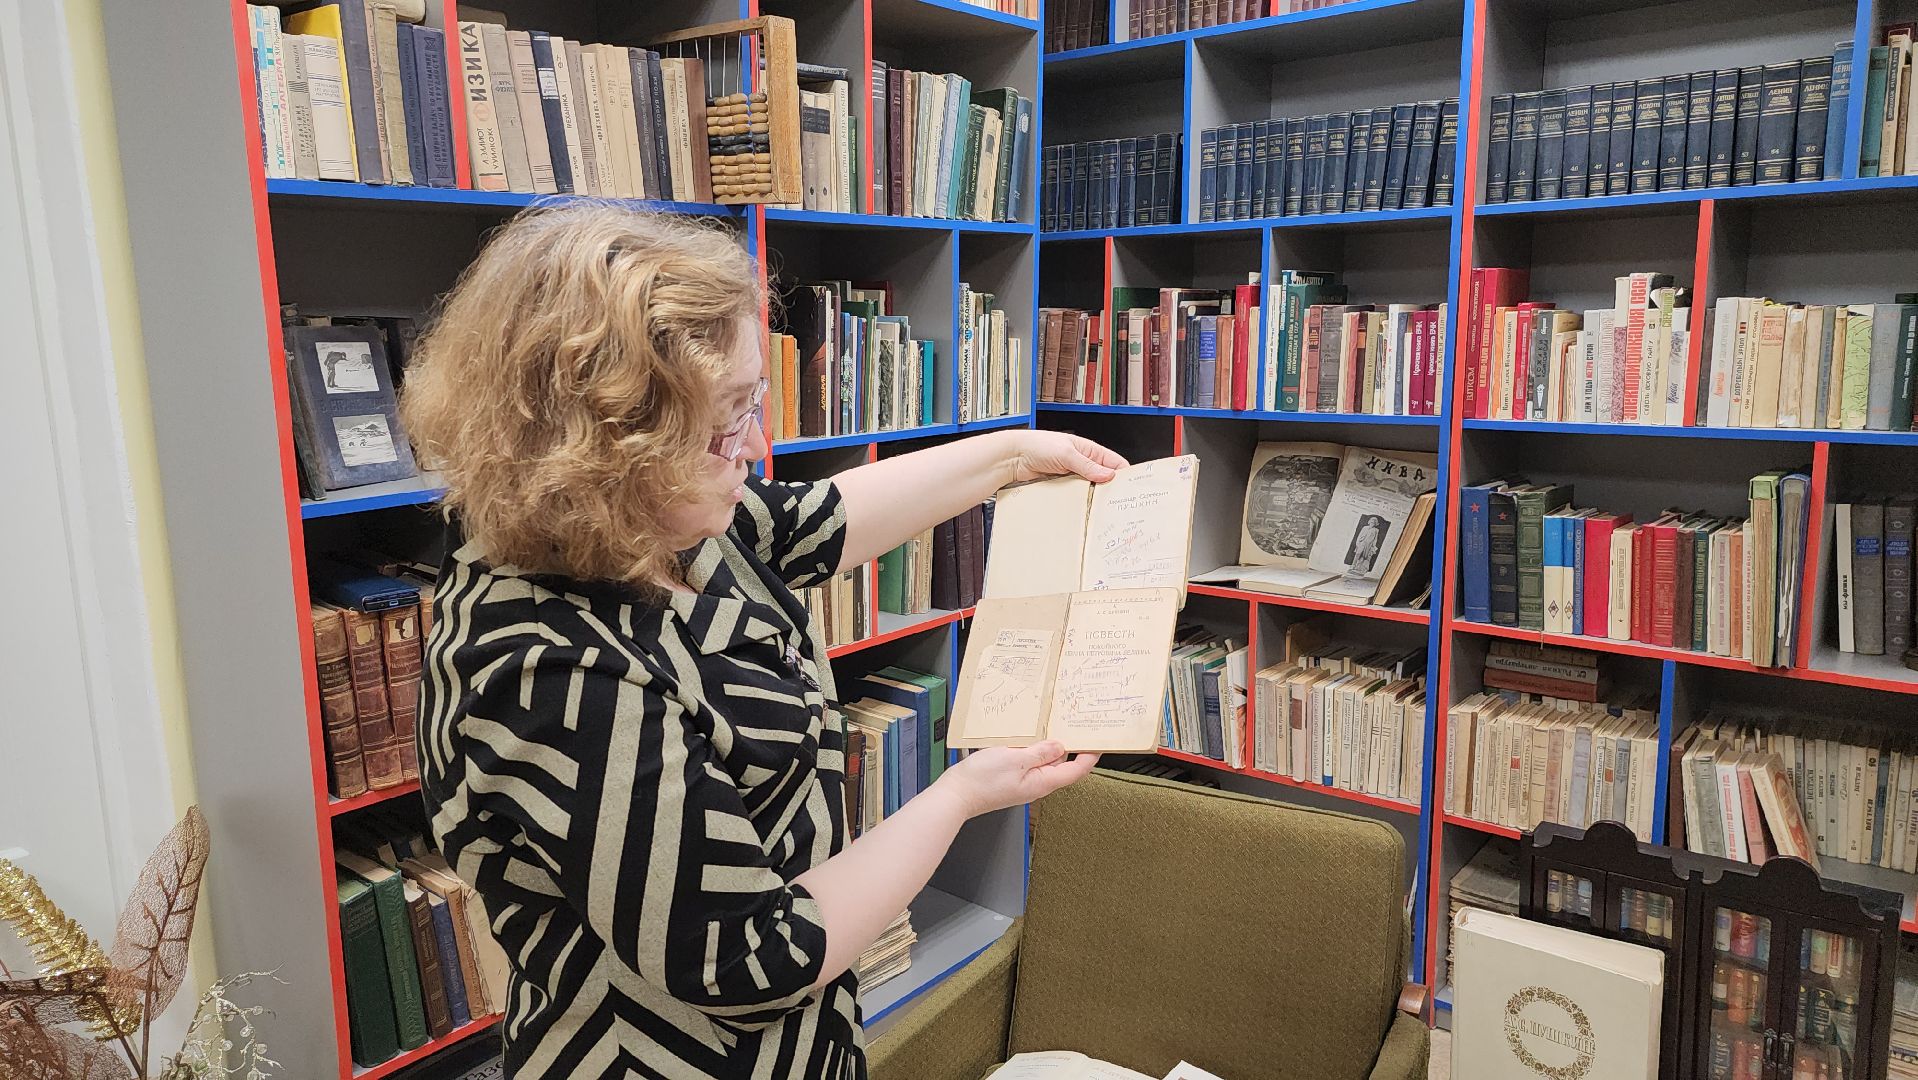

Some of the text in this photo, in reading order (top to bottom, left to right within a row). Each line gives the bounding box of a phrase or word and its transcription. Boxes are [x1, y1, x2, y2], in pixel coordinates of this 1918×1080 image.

[275, 57, 287, 111] АЛГЕБРА
[652, 76, 663, 128] ТЕОРИЯ ПОЛЯ
[560, 93, 573, 129] МЕХАНИКА
[1414, 321, 1423, 335] ВЧК
[1428, 321, 1437, 335] ВЧК
[1584, 379, 1593, 395] ГОДЫ
[1584, 401, 1592, 413] ДНИ
[1365, 456, 1426, 481] НИВА
[1085, 629, 1136, 640] ПОВЕСТИ
